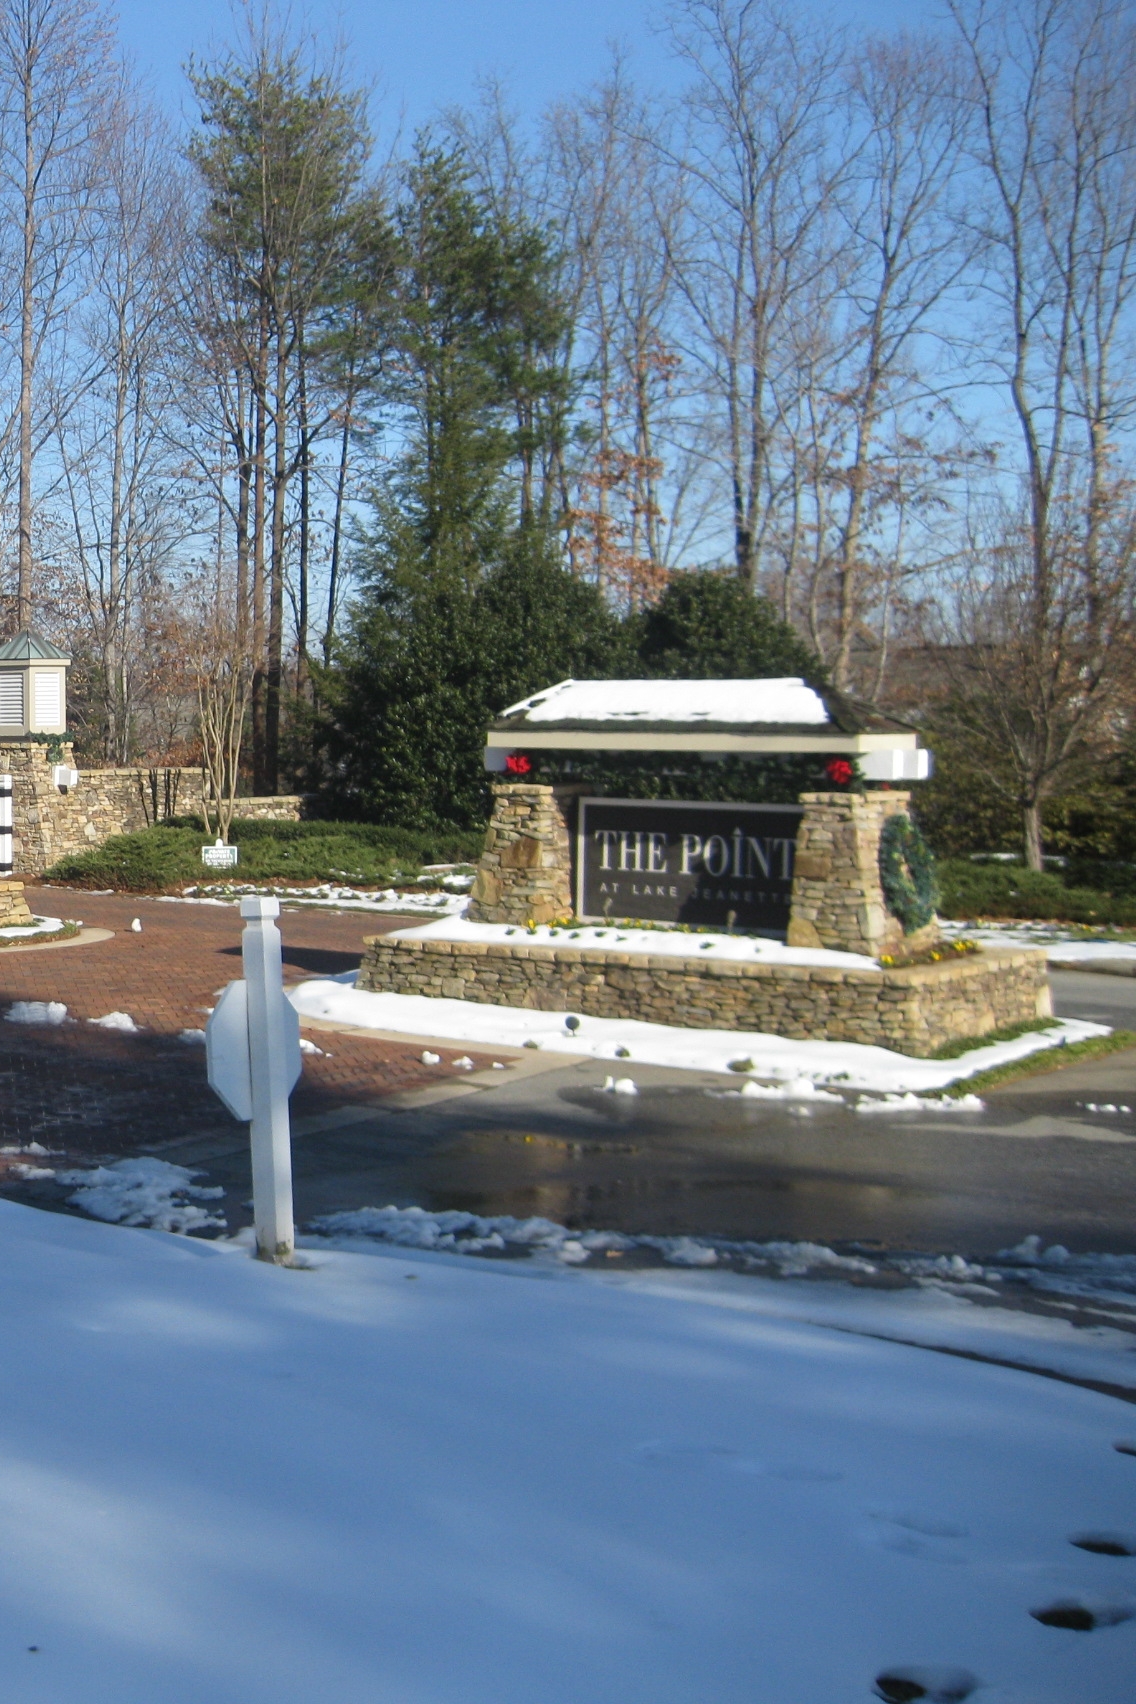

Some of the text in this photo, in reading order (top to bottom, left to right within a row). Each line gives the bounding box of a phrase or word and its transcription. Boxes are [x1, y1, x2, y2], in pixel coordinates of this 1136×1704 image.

[595, 826, 797, 881] THE POINT
[600, 882, 619, 894] AT
[632, 884, 678, 897] LAKE
